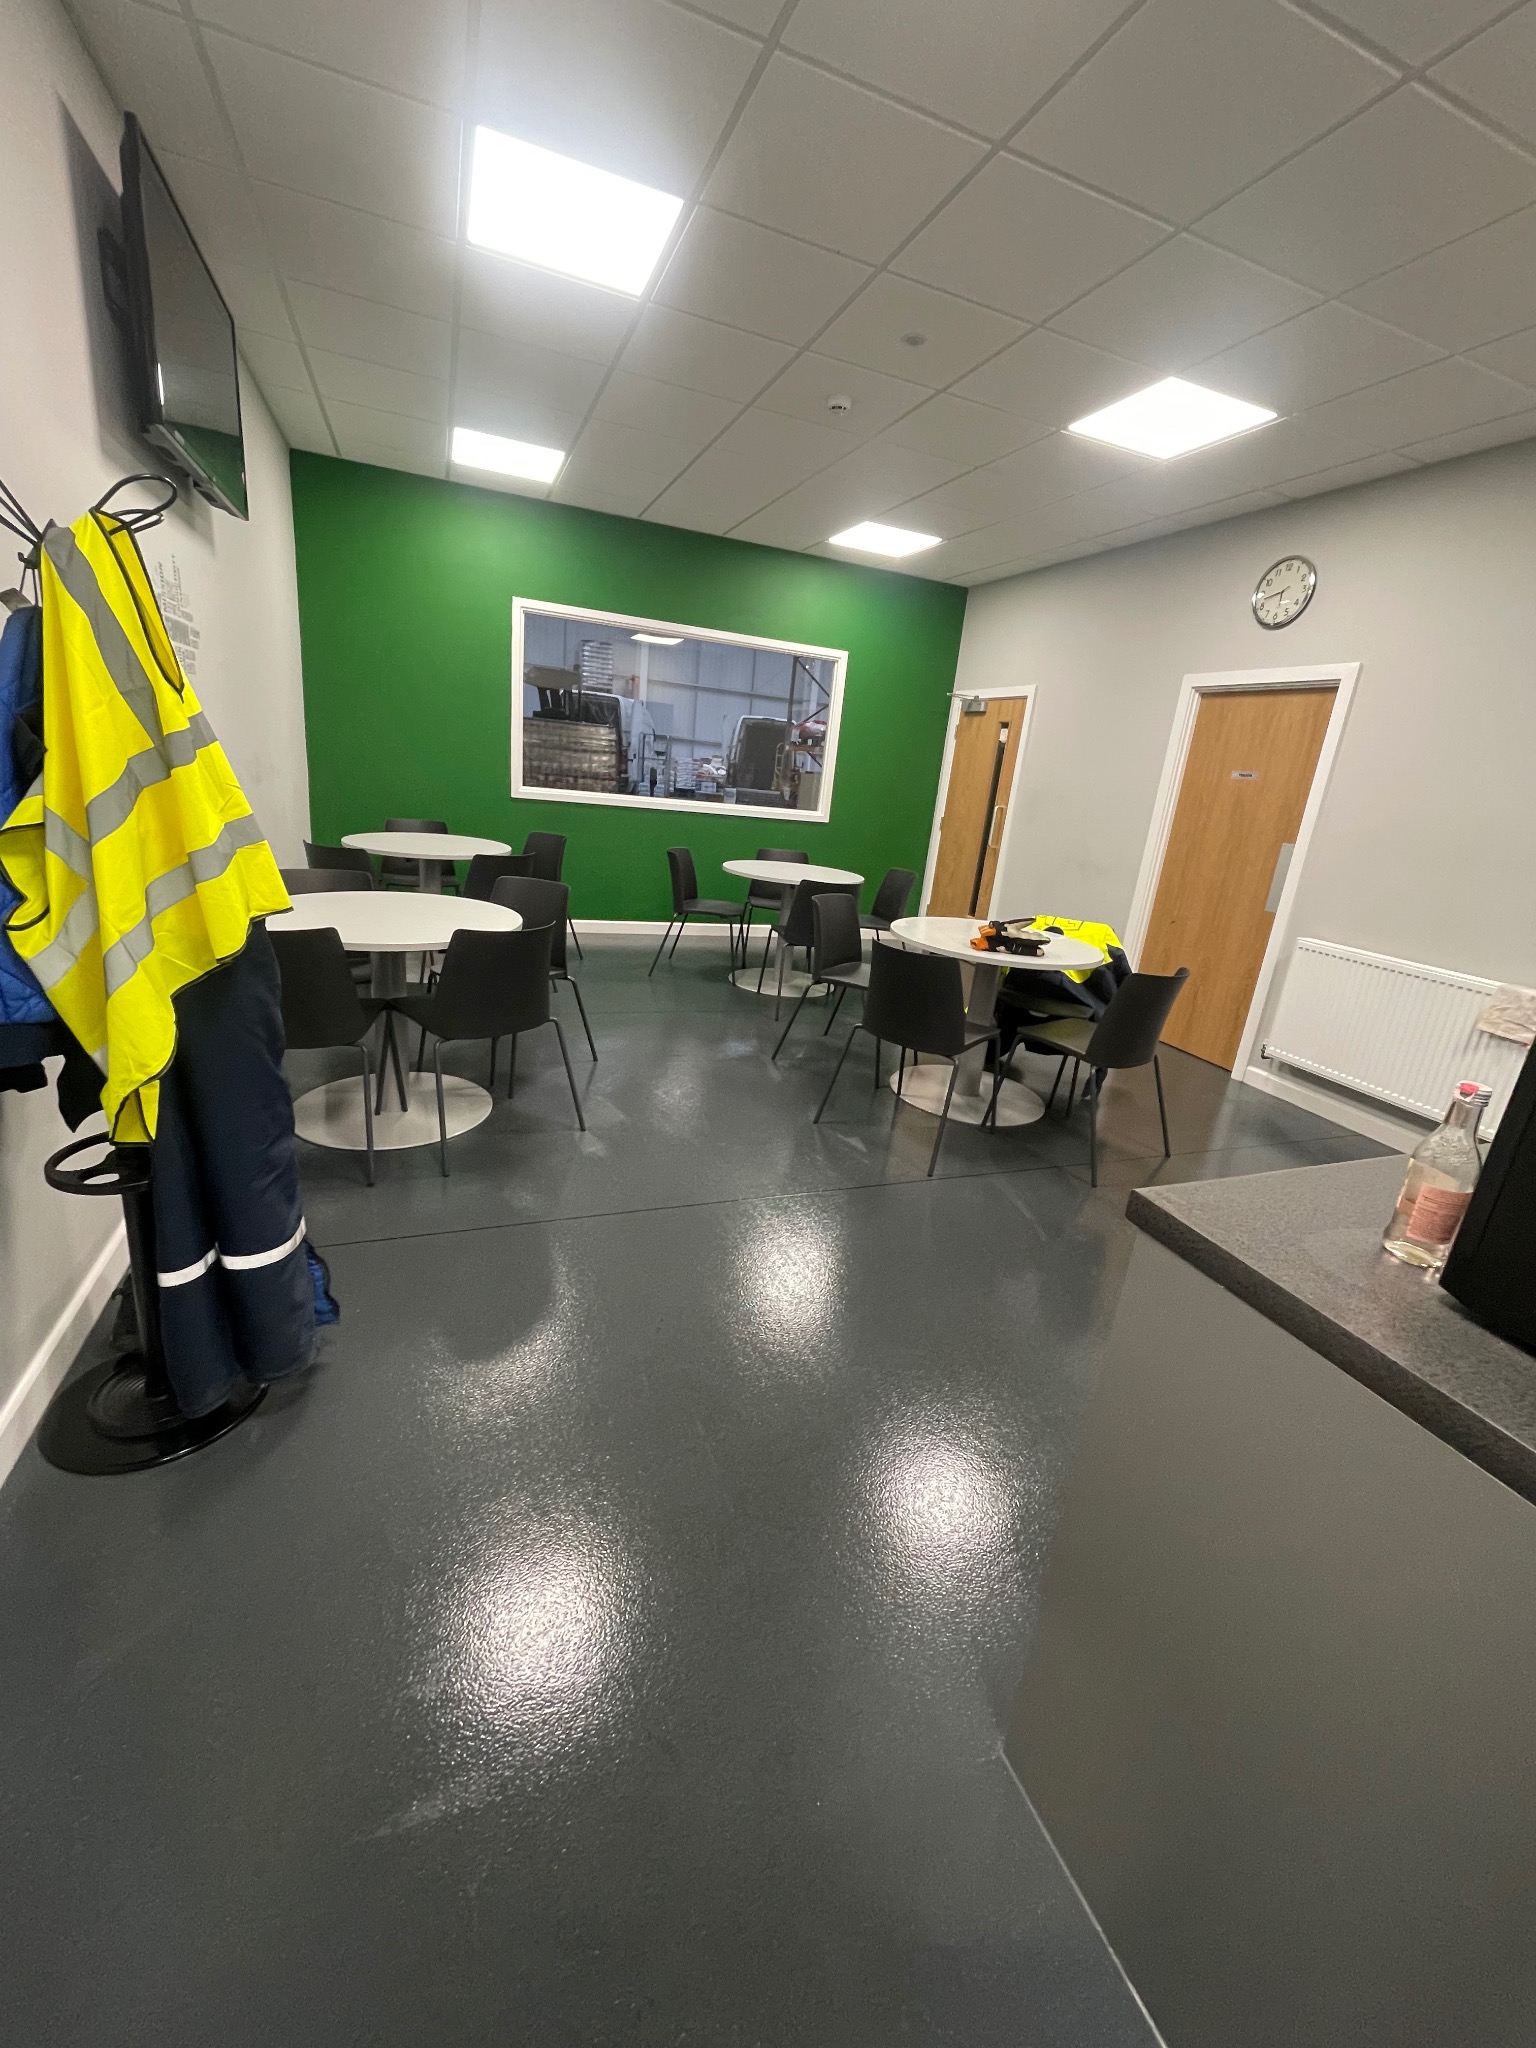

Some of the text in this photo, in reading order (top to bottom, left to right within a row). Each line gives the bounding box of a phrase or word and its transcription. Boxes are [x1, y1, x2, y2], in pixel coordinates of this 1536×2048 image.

[1266, 579, 1273, 587] 10
[1302, 585, 1306, 593] 3
[1260, 602, 1264, 610] 8
[1265, 610, 1270, 618] 7
[1273, 612, 1278, 620] 6
[1284, 608, 1289, 616] 5
